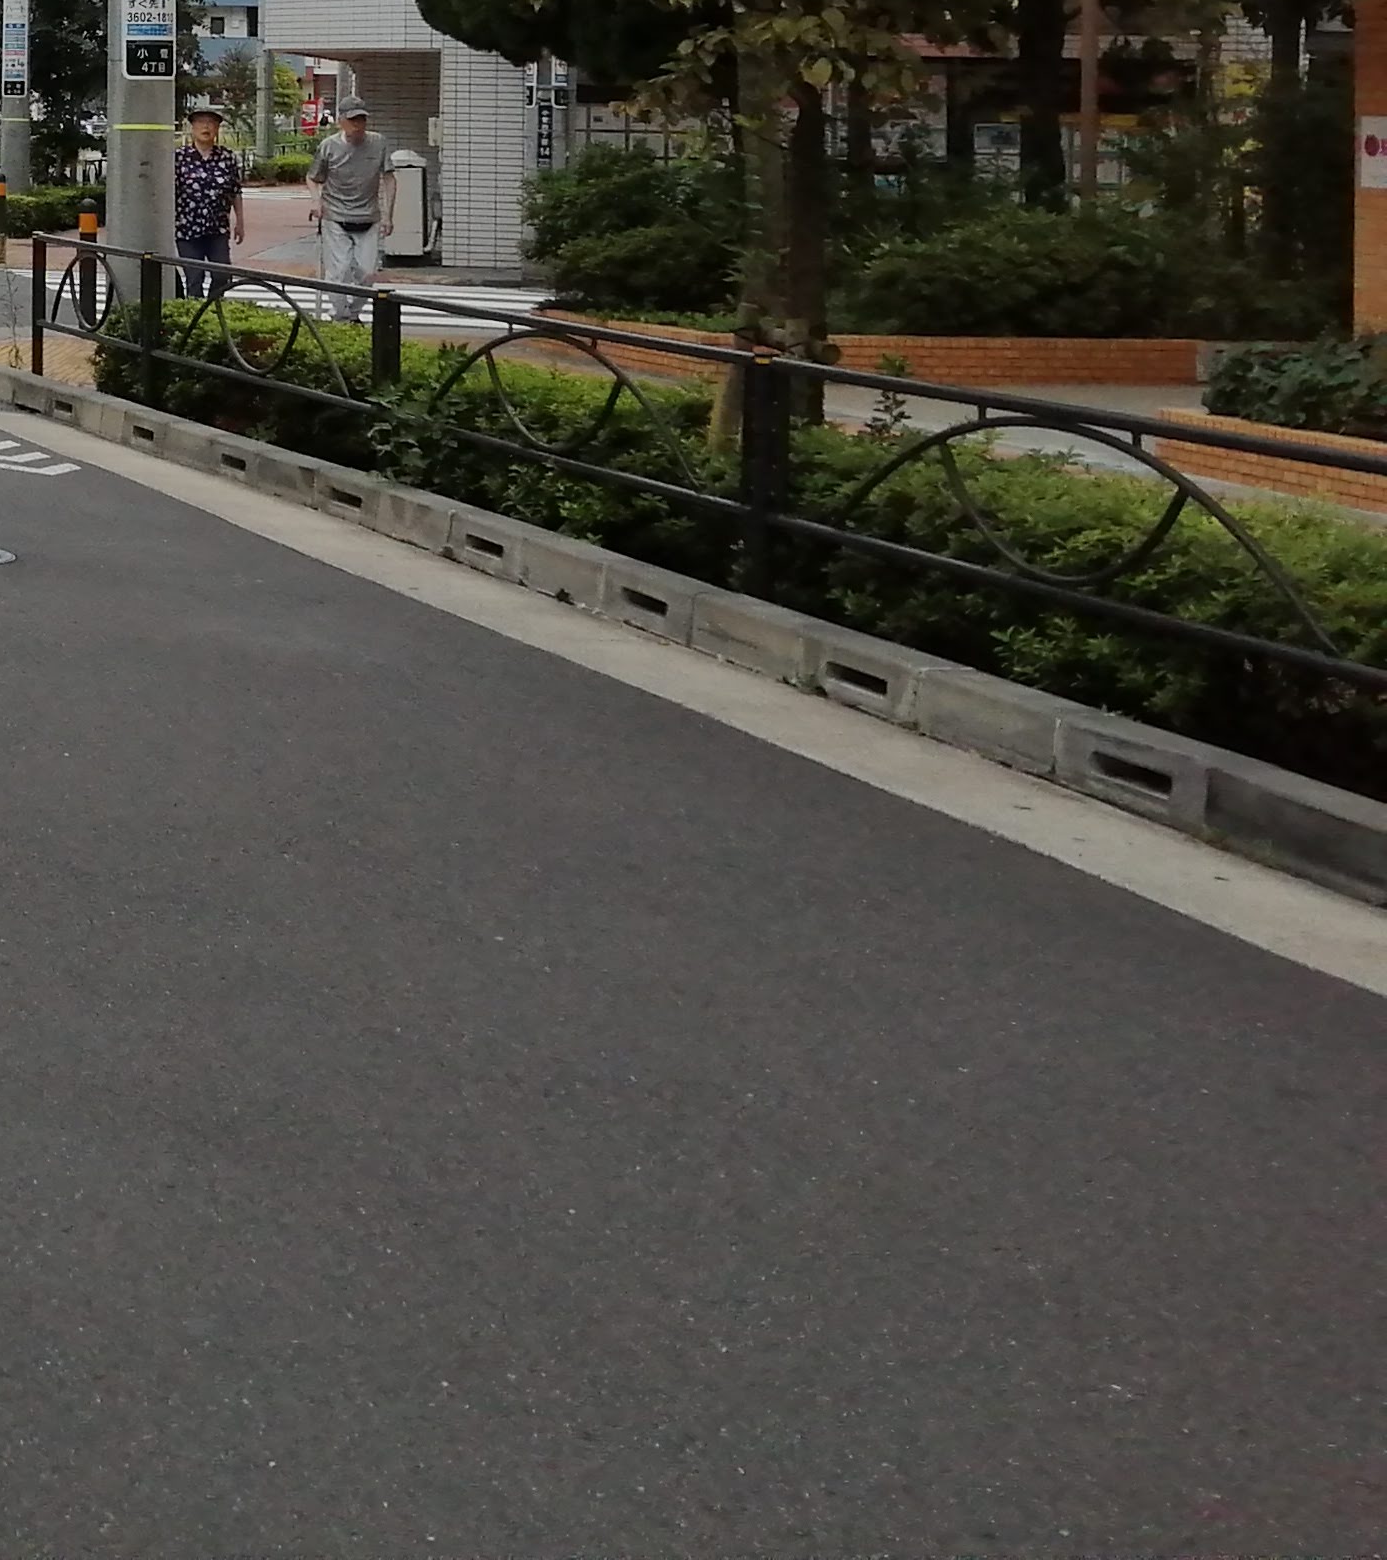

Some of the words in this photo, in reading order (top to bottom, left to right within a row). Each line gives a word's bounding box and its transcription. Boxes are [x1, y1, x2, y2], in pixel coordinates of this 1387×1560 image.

[128, 0, 159, 9] すぐ先
[141, 62, 166, 73] 4丁目
